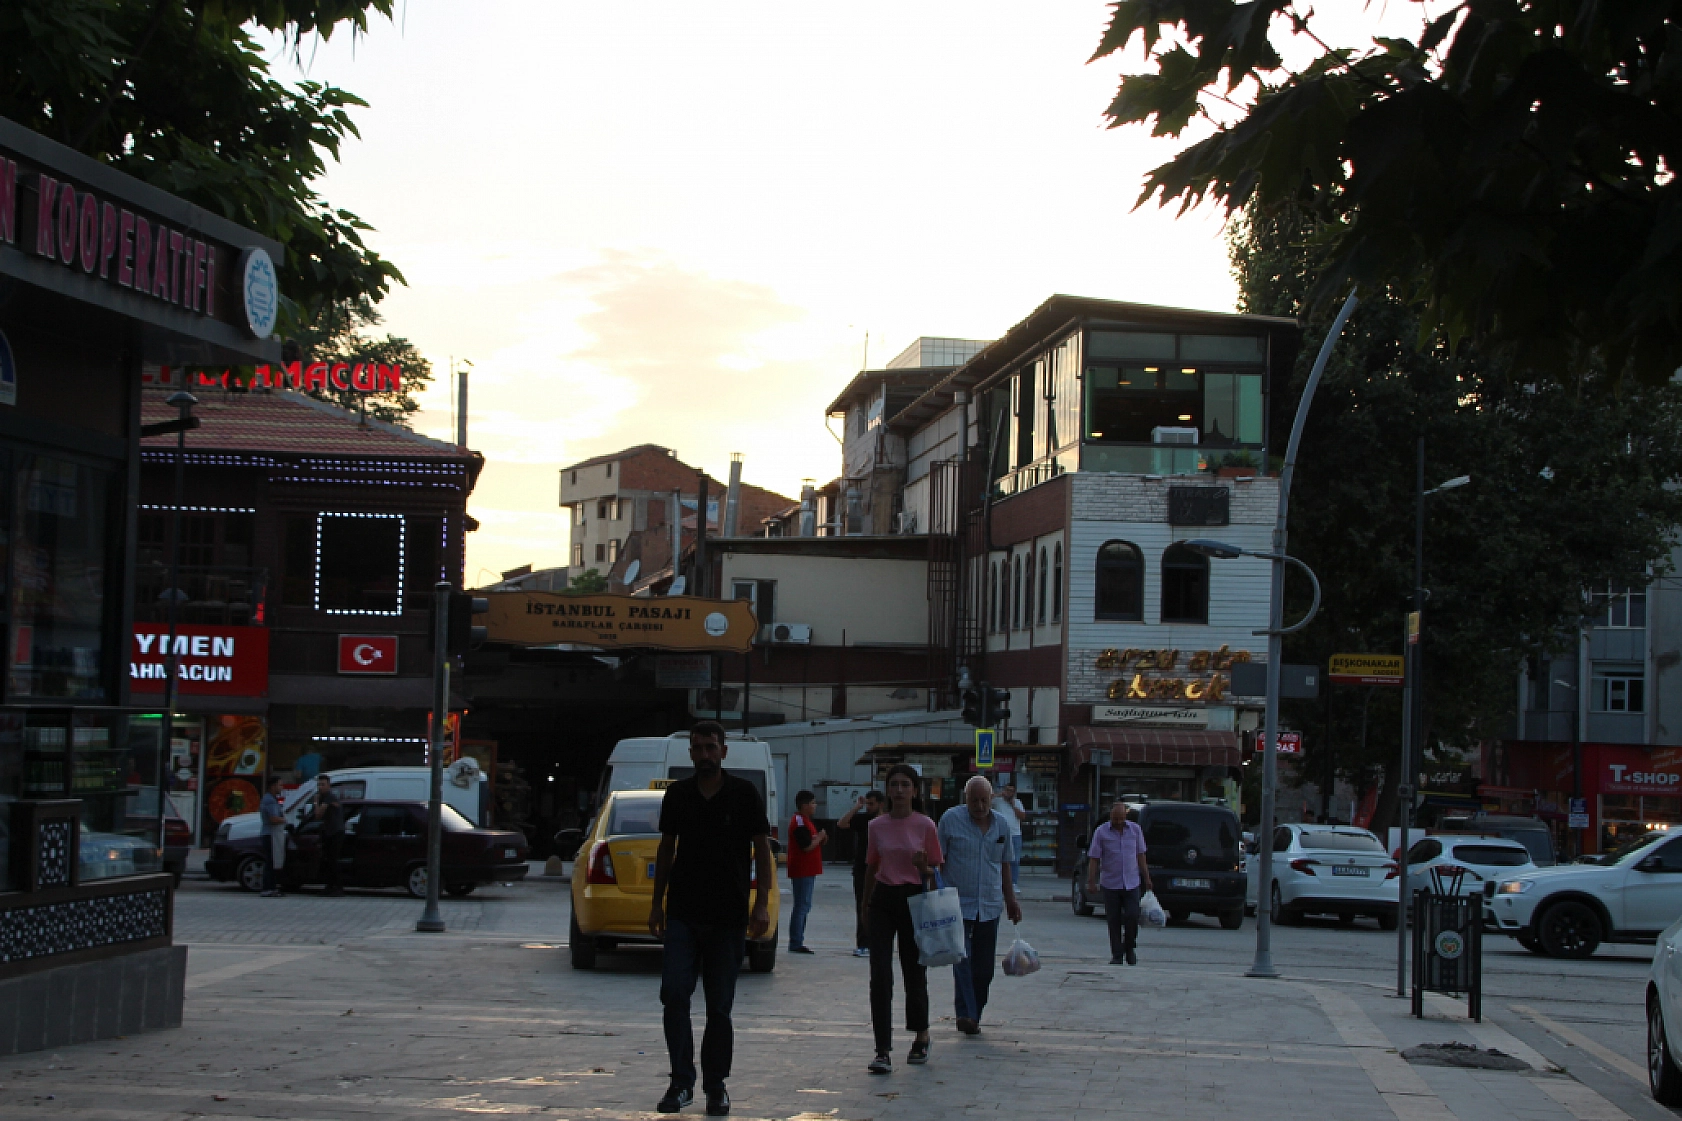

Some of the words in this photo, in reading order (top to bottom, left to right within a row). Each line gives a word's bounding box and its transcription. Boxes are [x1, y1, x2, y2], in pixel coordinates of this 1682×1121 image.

[36, 173, 216, 316] KOOPERATİFİ
[526, 600, 615, 617] İSTANBUL
[628, 605, 691, 620] PASAJI
[1333, 658, 1400, 668] BEŞKONAKLAR
[1108, 673, 1231, 700] ekmek
